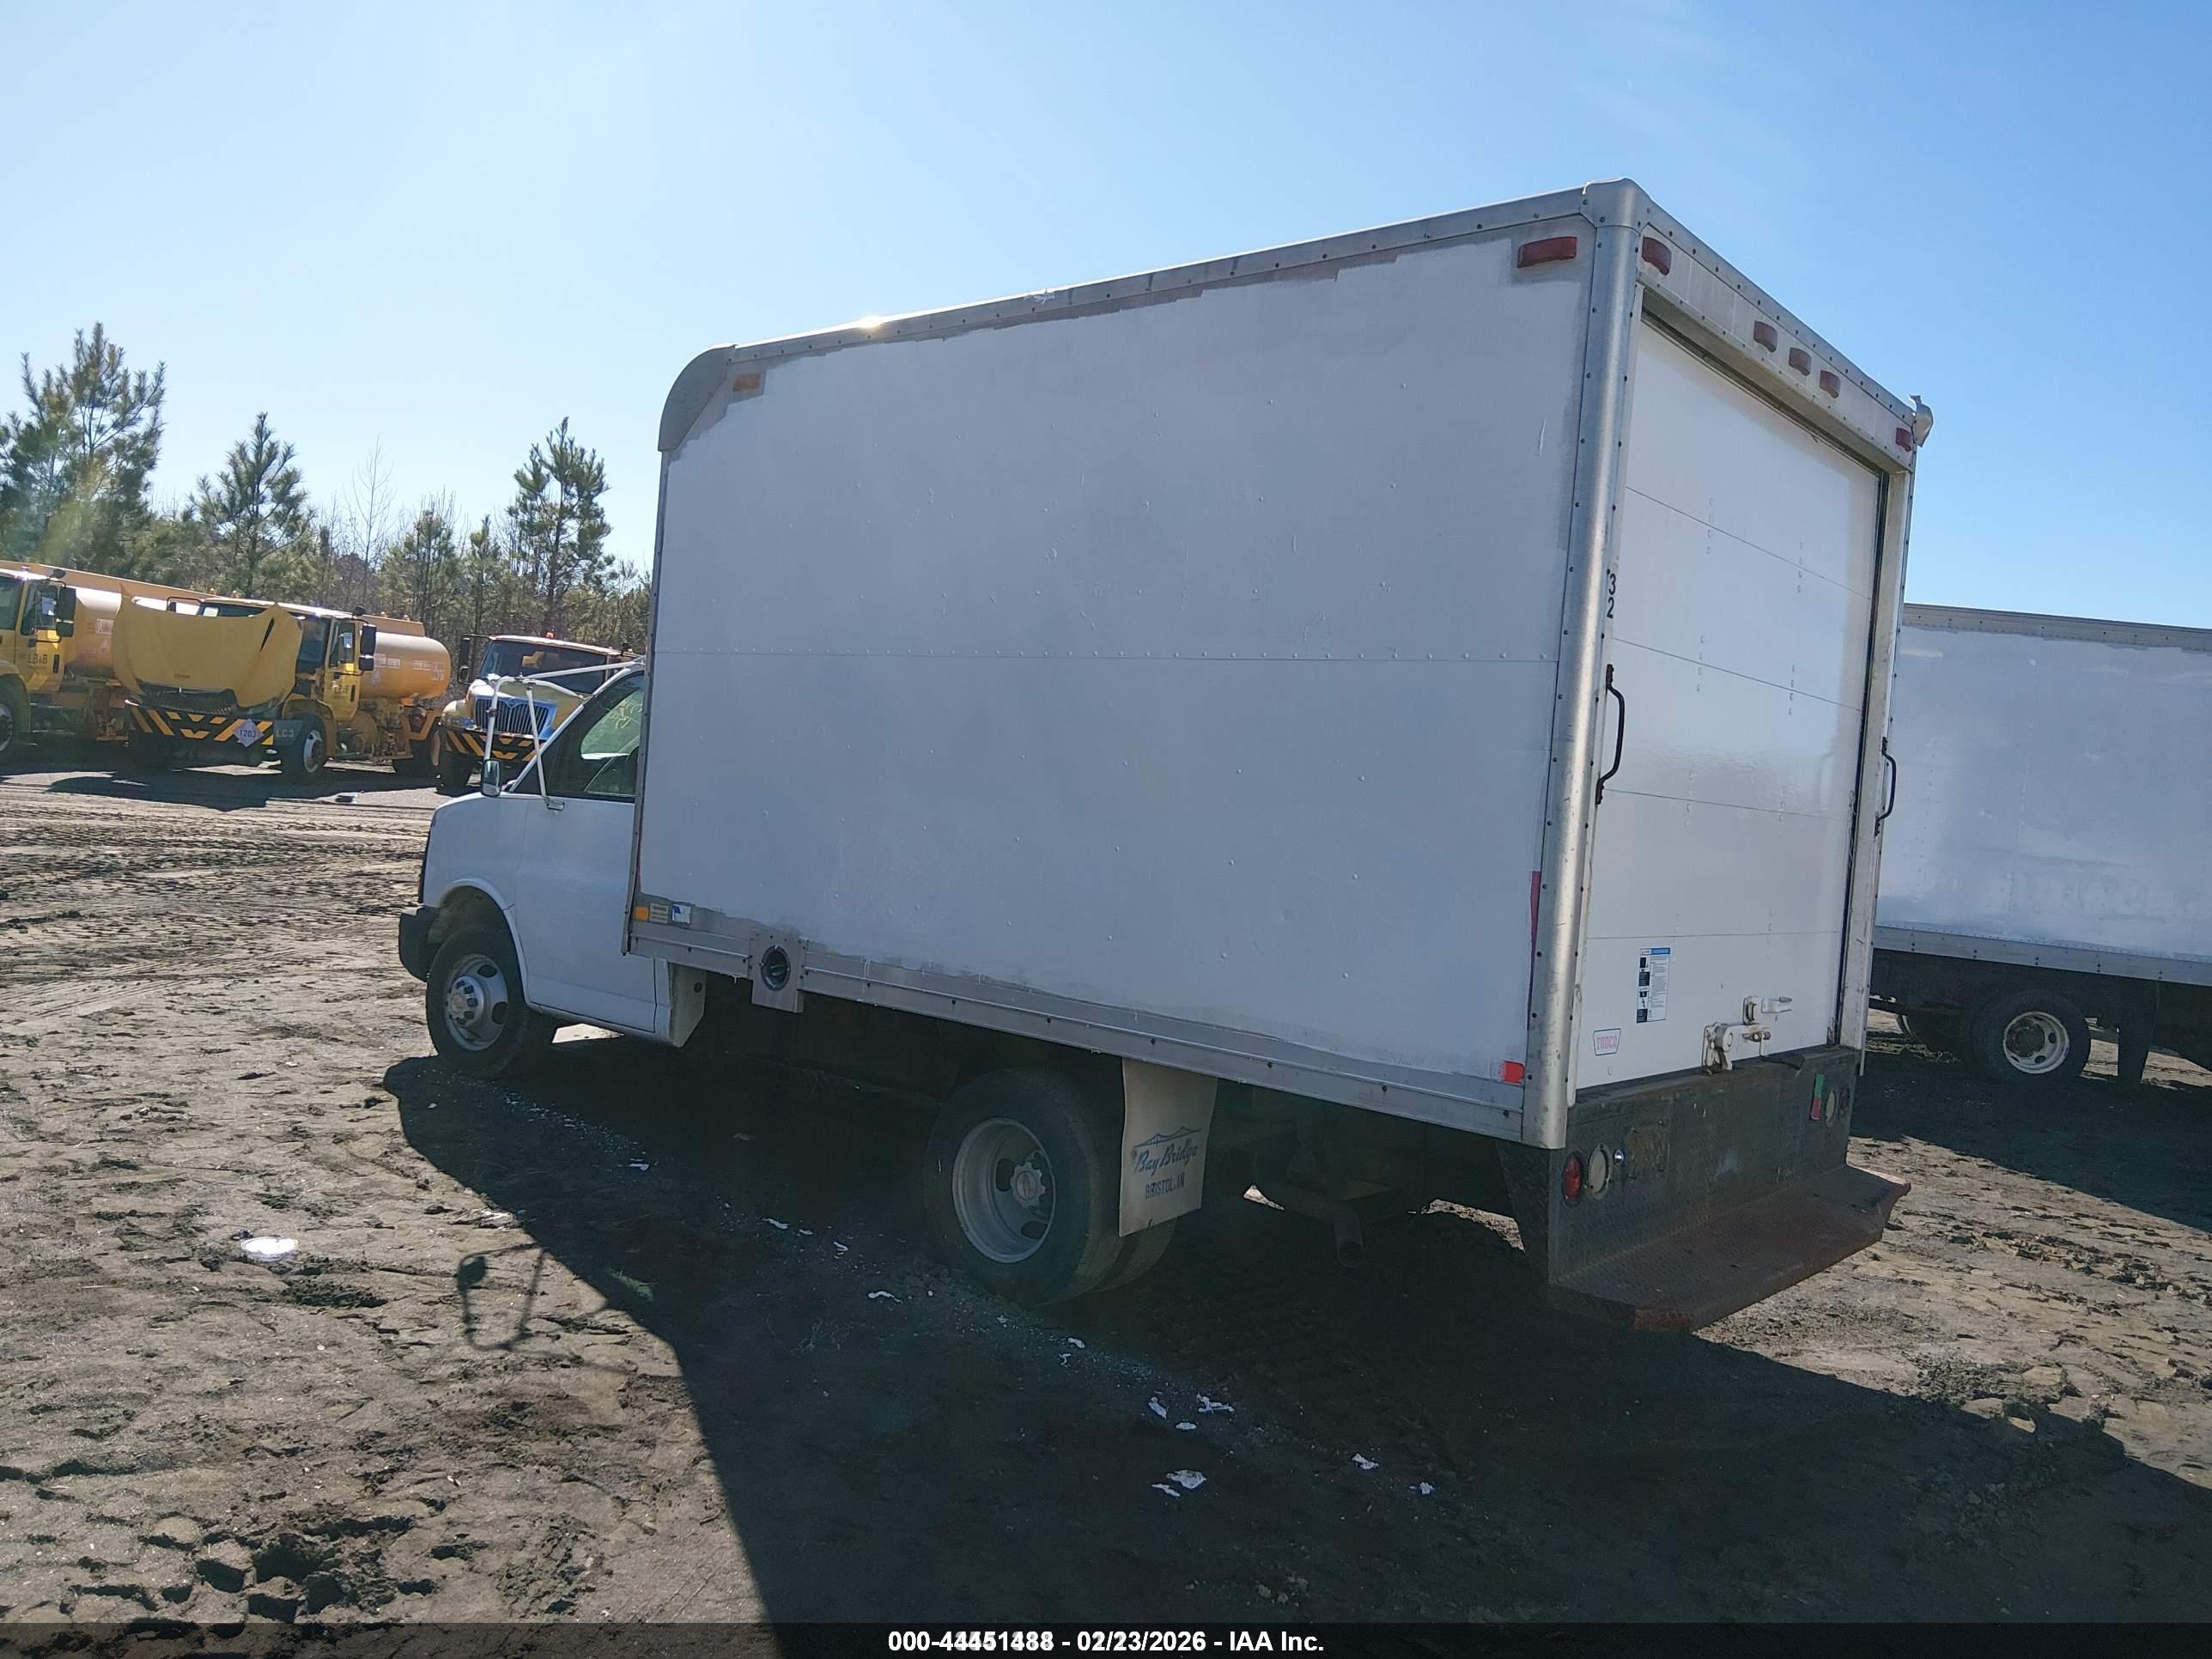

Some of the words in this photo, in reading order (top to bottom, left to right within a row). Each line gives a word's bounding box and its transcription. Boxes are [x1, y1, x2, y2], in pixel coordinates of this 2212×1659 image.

[240, 729, 257, 738] 1203
[1134, 1149, 1159, 1177] Bay
[1159, 1139, 1198, 1166] Bridge
